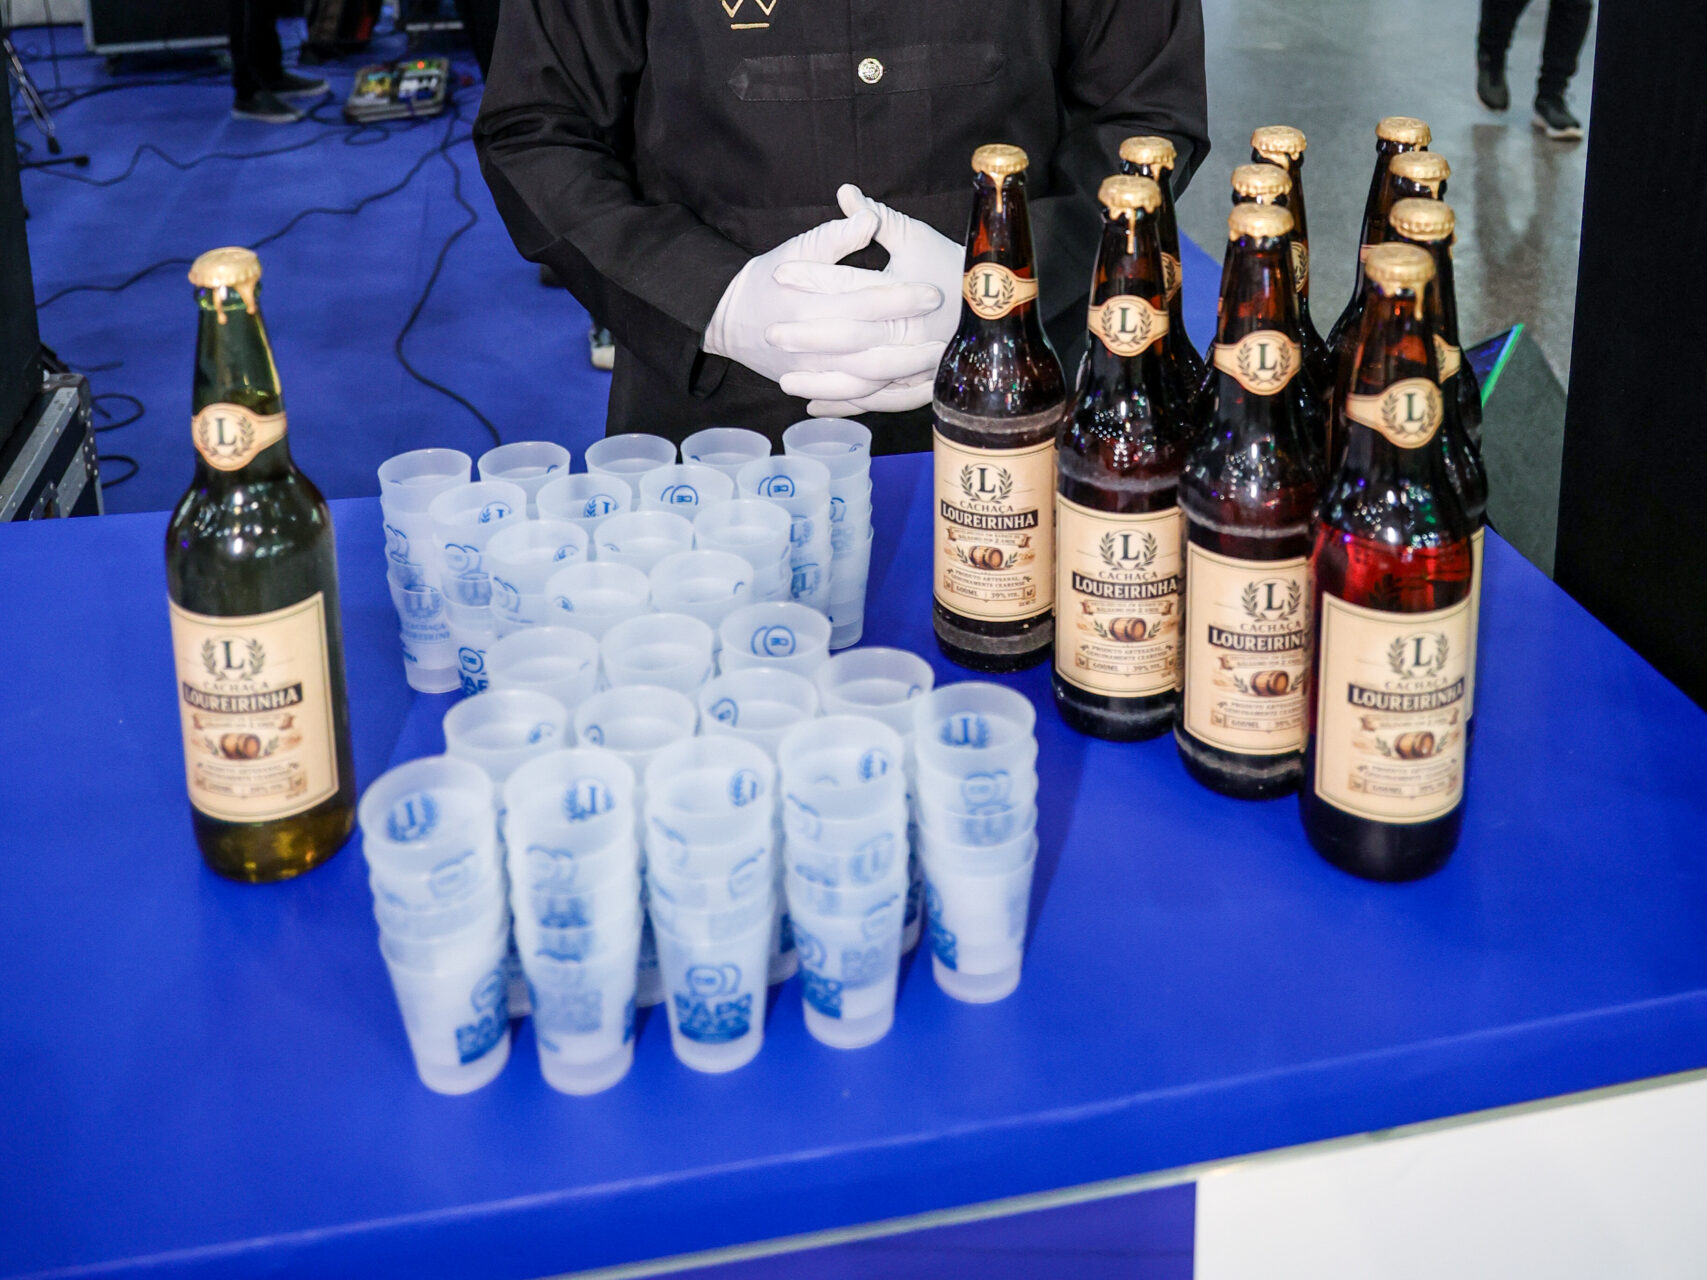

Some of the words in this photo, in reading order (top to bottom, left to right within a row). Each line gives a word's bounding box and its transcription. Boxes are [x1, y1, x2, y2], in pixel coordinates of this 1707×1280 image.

[982, 273, 1000, 298] L
[1118, 307, 1138, 333] L
[1258, 343, 1278, 371] L
[1403, 392, 1426, 422] L
[215, 417, 237, 446] L
[977, 467, 996, 493] L
[942, 503, 1035, 529] LOUREIRINHA
[960, 501, 1014, 514] CACHAÇA
[1120, 534, 1140, 561] L
[1075, 575, 1177, 599] LOUREIRINHA
[1099, 571, 1158, 582] CACHAÇA
[1264, 583, 1284, 610] L
[1241, 620, 1302, 633] CACHAÇA
[1212, 629, 1303, 651] LOUREIRIN
[1413, 636, 1432, 667] L
[221, 640, 245, 670] L
[184, 686, 299, 712] LOUREIRINHA
[1352, 681, 1463, 711] LOUREIRINHA
